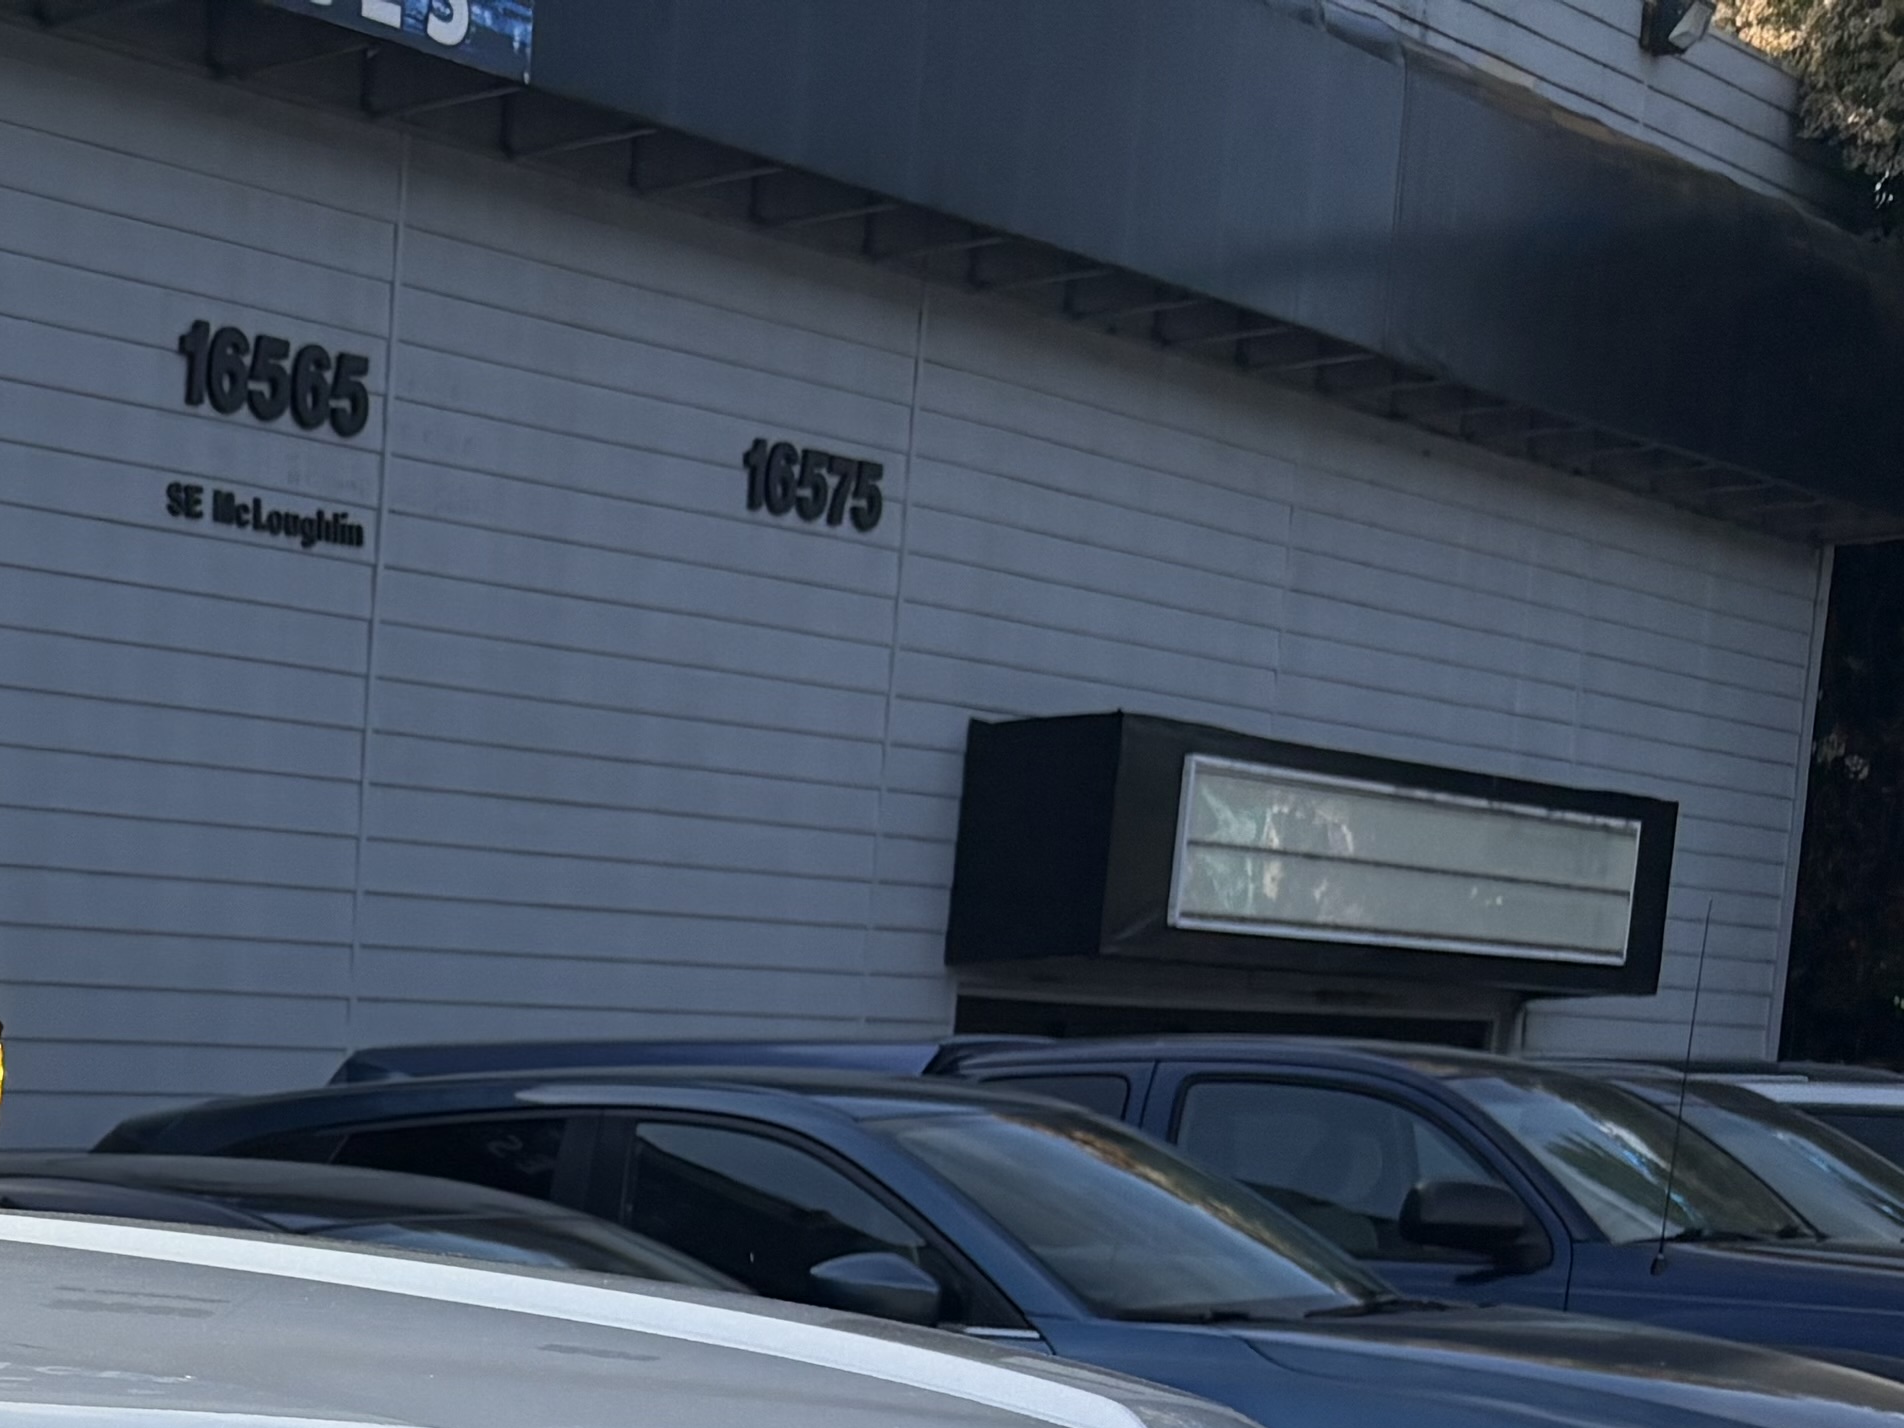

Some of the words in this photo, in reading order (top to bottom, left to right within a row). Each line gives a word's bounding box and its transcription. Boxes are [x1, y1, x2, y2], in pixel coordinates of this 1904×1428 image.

[178, 319, 370, 439] 16565
[166, 481, 204, 520] SE
[212, 488, 365, 548] McLoughlin
[743, 437, 884, 533] 16575
